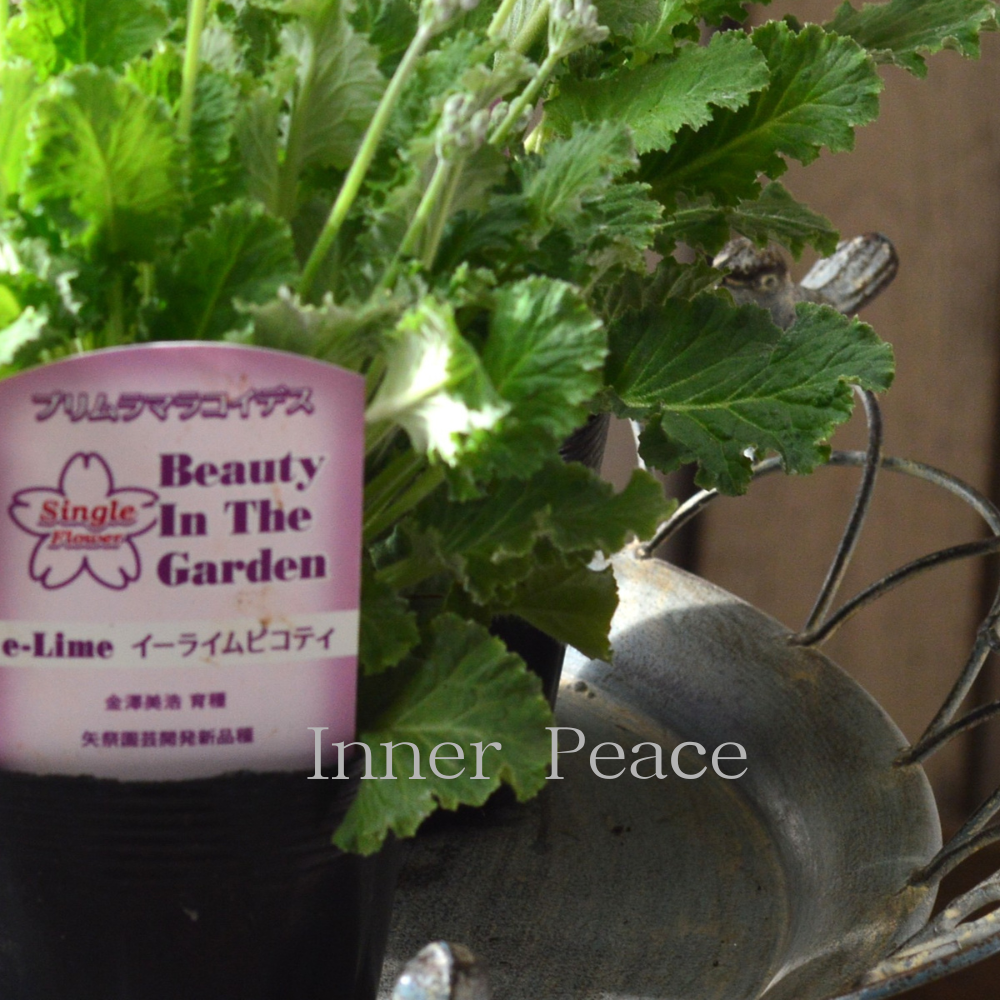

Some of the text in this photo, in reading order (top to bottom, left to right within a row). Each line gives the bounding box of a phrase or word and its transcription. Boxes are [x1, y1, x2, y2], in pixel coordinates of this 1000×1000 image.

[32, 385, 315, 422] プリムラマラコイデス
[158, 451, 325, 491] Beauty
[37, 499, 137, 527] Single
[157, 499, 313, 538] In The
[47, 530, 126, 550] Flower
[156, 549, 327, 588] Garden
[1, 632, 115, 659] e-Lime
